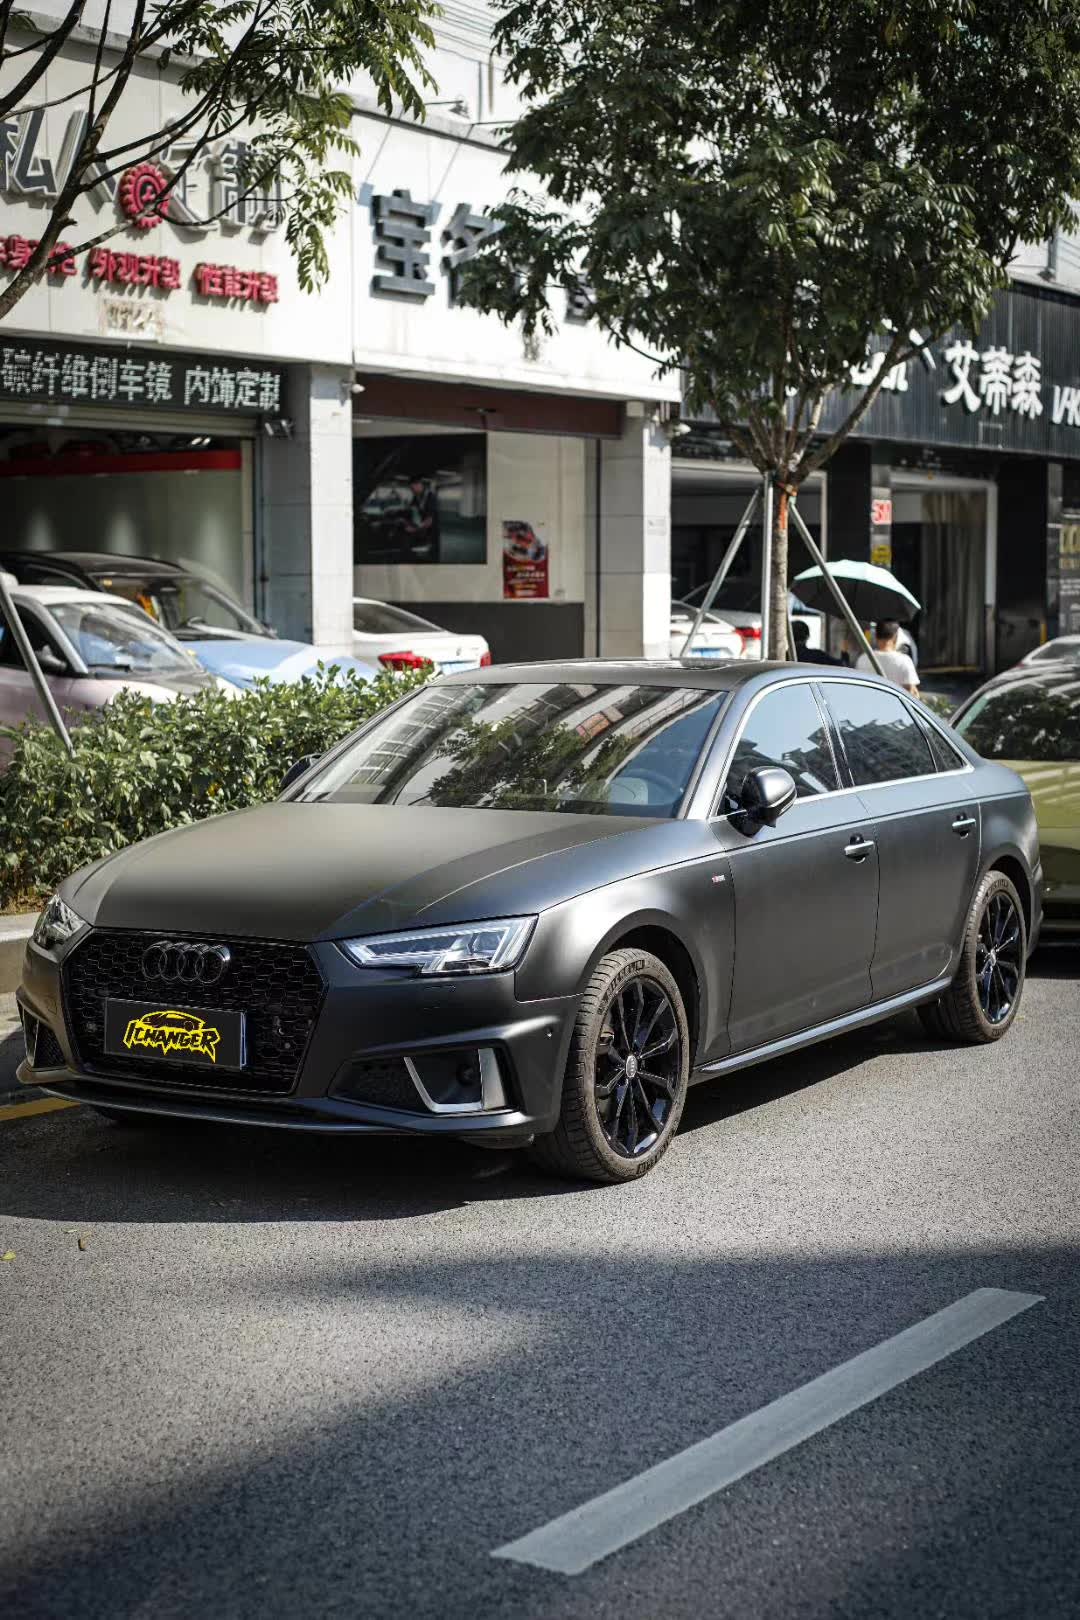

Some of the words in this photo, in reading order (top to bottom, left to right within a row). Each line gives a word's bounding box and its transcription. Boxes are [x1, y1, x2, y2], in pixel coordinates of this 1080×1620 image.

[90, 247, 181, 289] 外观升级
[194, 262, 279, 304] 性能升级
[1, 347, 173, 403] 碳纤维倒车镜
[184, 364, 281, 412] 内饰定制
